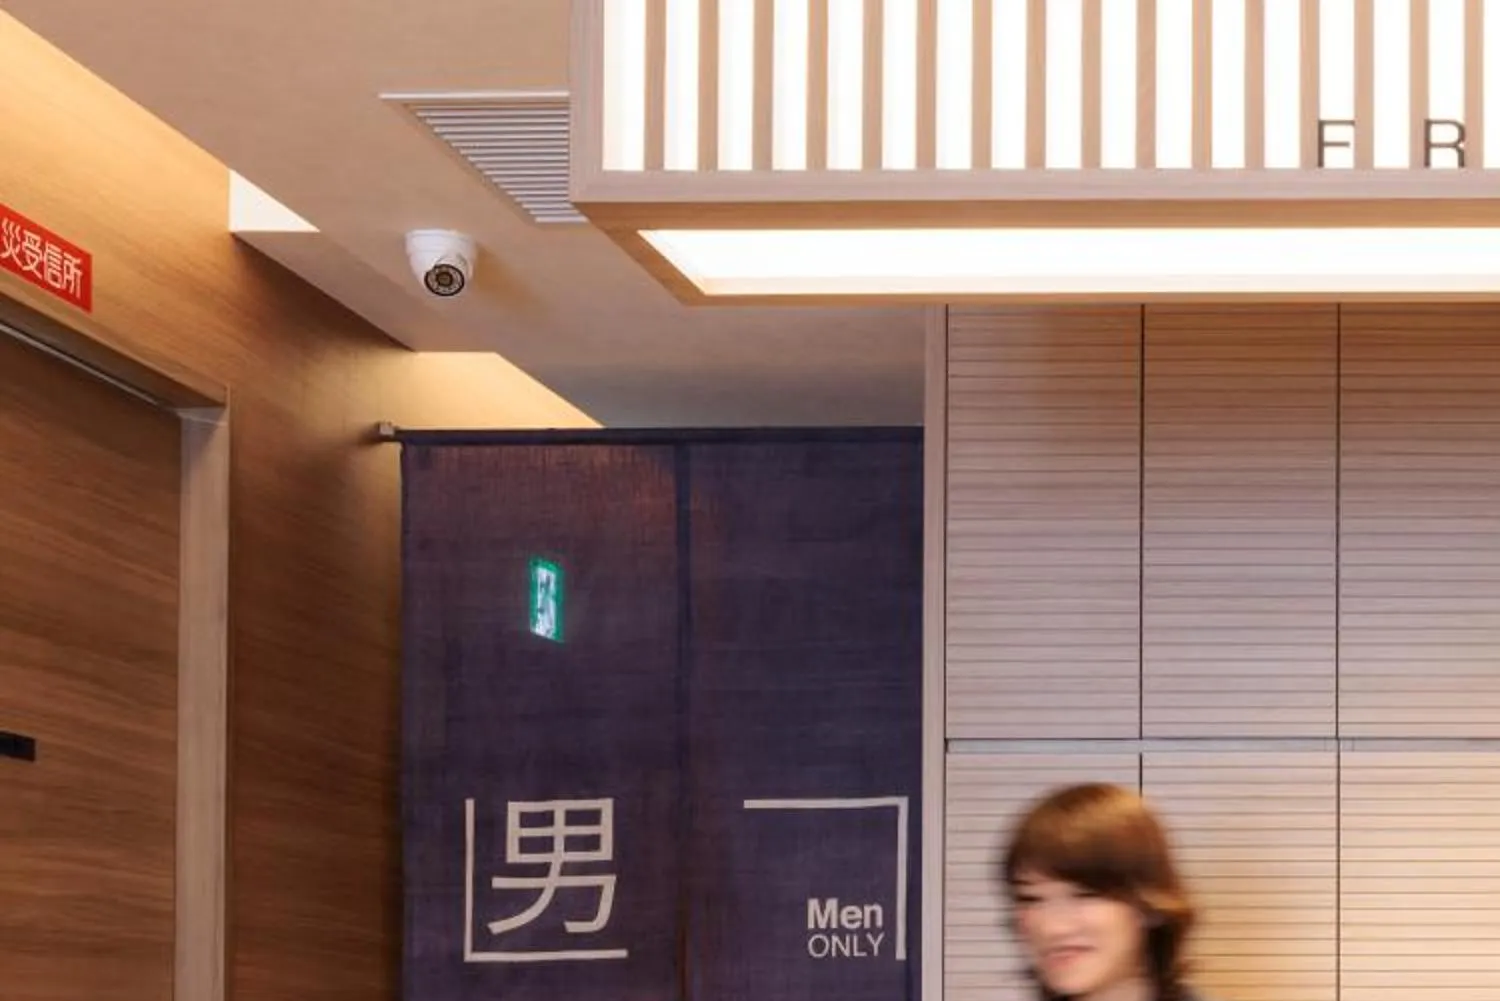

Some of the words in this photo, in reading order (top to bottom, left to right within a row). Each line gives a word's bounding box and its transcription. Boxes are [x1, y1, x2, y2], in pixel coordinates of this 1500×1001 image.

[0, 218, 82, 298] 災受信所
[488, 798, 616, 935] 男
[807, 898, 883, 929] Men
[807, 934, 884, 958] ONLY
